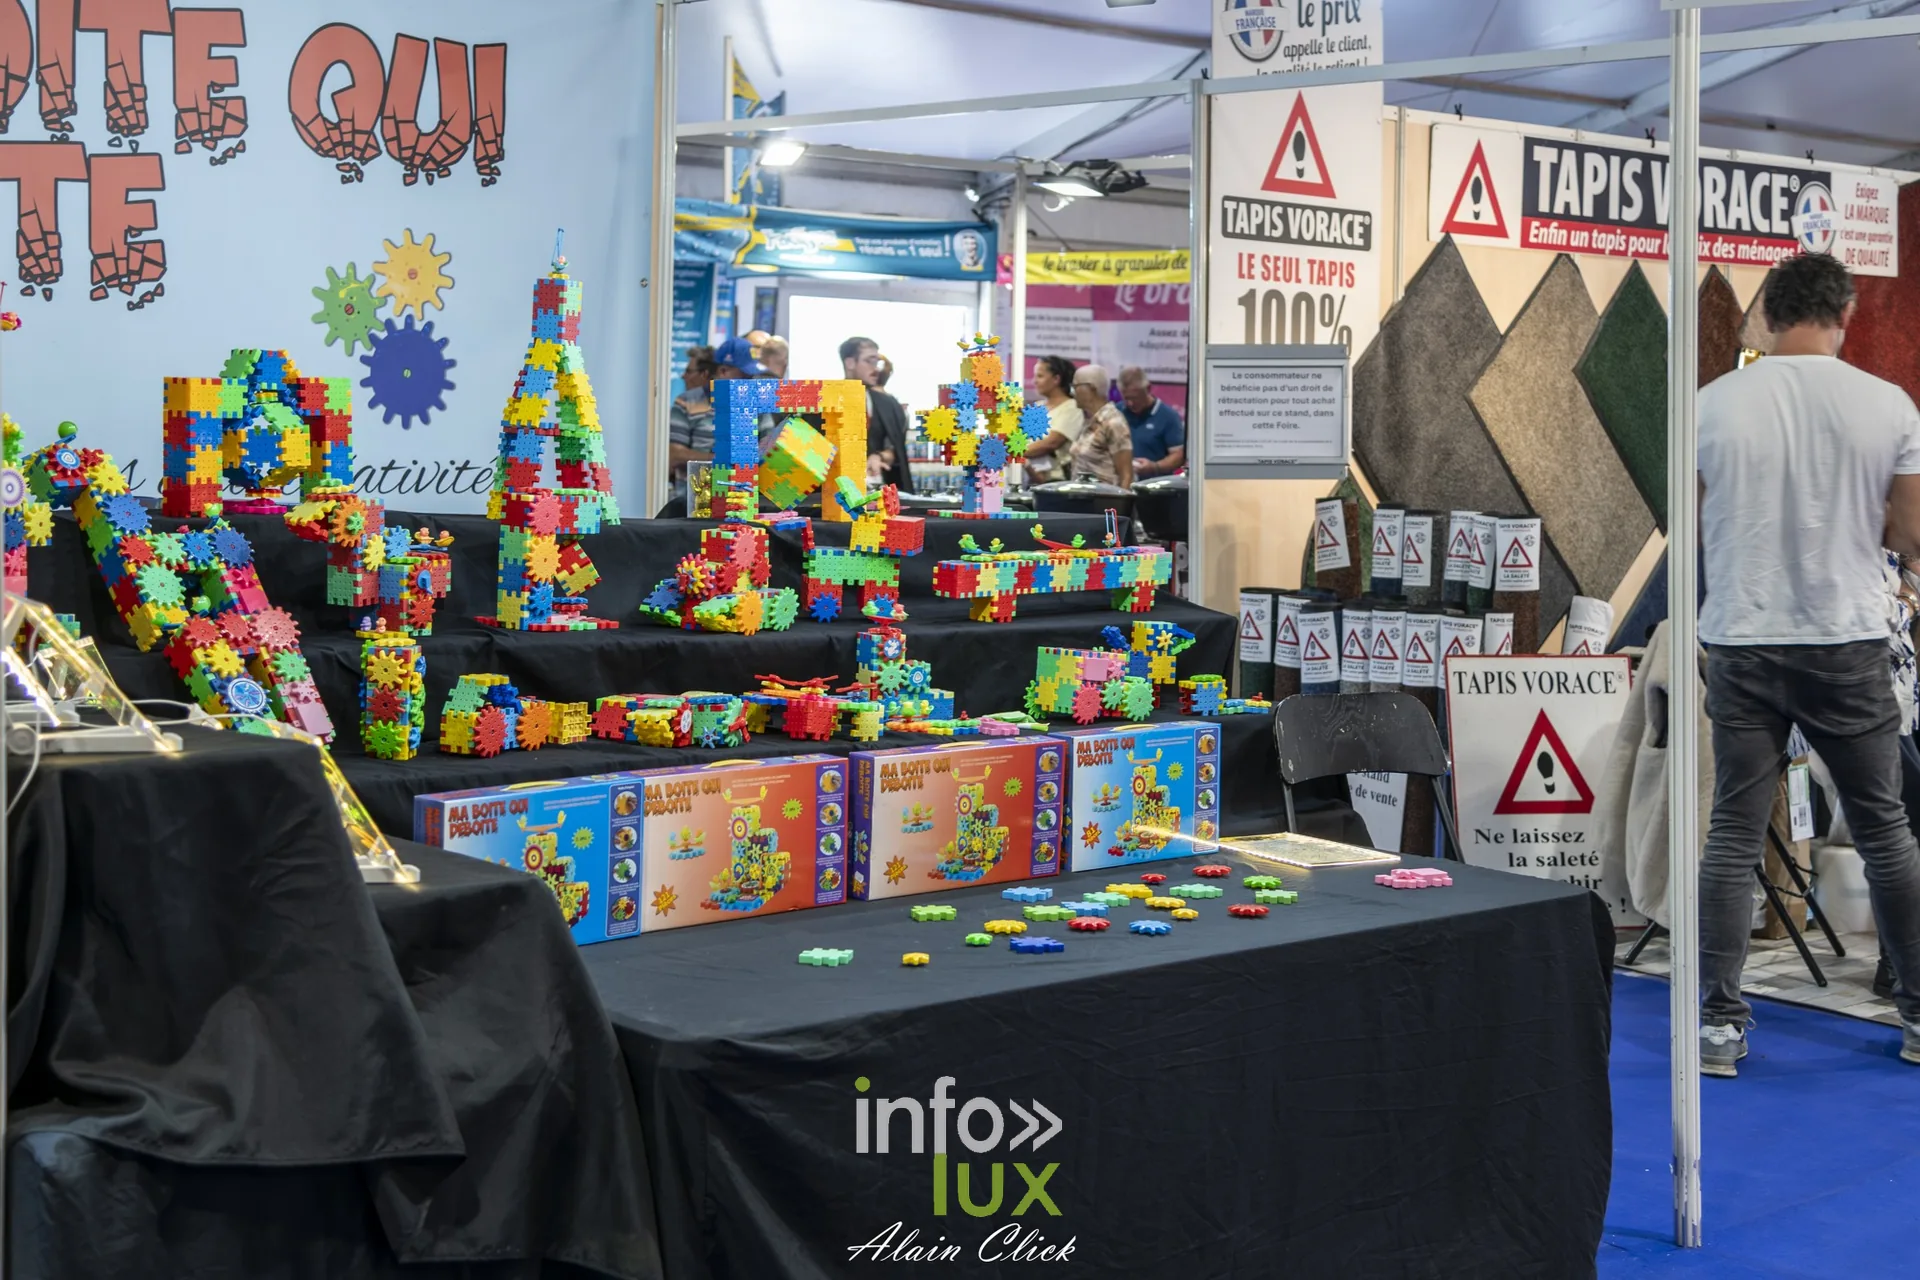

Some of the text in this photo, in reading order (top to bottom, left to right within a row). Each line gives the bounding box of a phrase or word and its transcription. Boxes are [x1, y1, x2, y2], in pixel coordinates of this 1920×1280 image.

[1236, 16, 1276, 32] FRANÇAISE
[1321, 0, 1361, 37] prix
[1283, 38, 1323, 62] appelle
[1326, 40, 1335, 54] le
[288, 22, 507, 180] QUI
[1533, 145, 1799, 235] TAPIS VRACE®
[1856, 182, 1879, 203] Exigez
[1223, 200, 1284, 238] TAPIS
[1845, 203, 1889, 224] LA MARQUE
[1529, 220, 1568, 246] Enfin
[1570, 231, 1589, 248] un
[1592, 229, 1626, 255] tapis
[1628, 240, 1661, 257] pour
[1712, 236, 1736, 259] des
[1737, 239, 1795, 262] ménages
[1855, 232, 1866, 241] une
[1043, 252, 1188, 276] le brasier à granulés de
[1845, 247, 1889, 268] DE QUALITÉ
[1238, 252, 1355, 289] LE SEUL TAPIS
[1238, 288, 1352, 350] 100%
[1232, 372, 1322, 380] Le consommateur ne
[1221, 383, 1333, 393] bénéficie pas d'un droit de
[1218, 396, 1269, 405] rétractation
[1270, 397, 1290, 406] pour
[1292, 397, 1309, 405] tout
[1219, 409, 1255, 417] effectué
[1313, 409, 1334, 417] dans
[1252, 421, 1301, 430] cette Foire.
[1453, 670, 1517, 695] TAPIS
[1077, 741, 1092, 755] MA
[880, 763, 899, 779] MA
[1355, 783, 1368, 799] de
[1370, 790, 1399, 808] vente
[448, 804, 469, 823] MA
[472, 800, 506, 819] BOITE
[509, 797, 529, 815] QUI
[449, 817, 499, 840] DEBOITE
[1474, 828, 1585, 845] Ne laissez
[1508, 849, 1600, 868] la saleté
